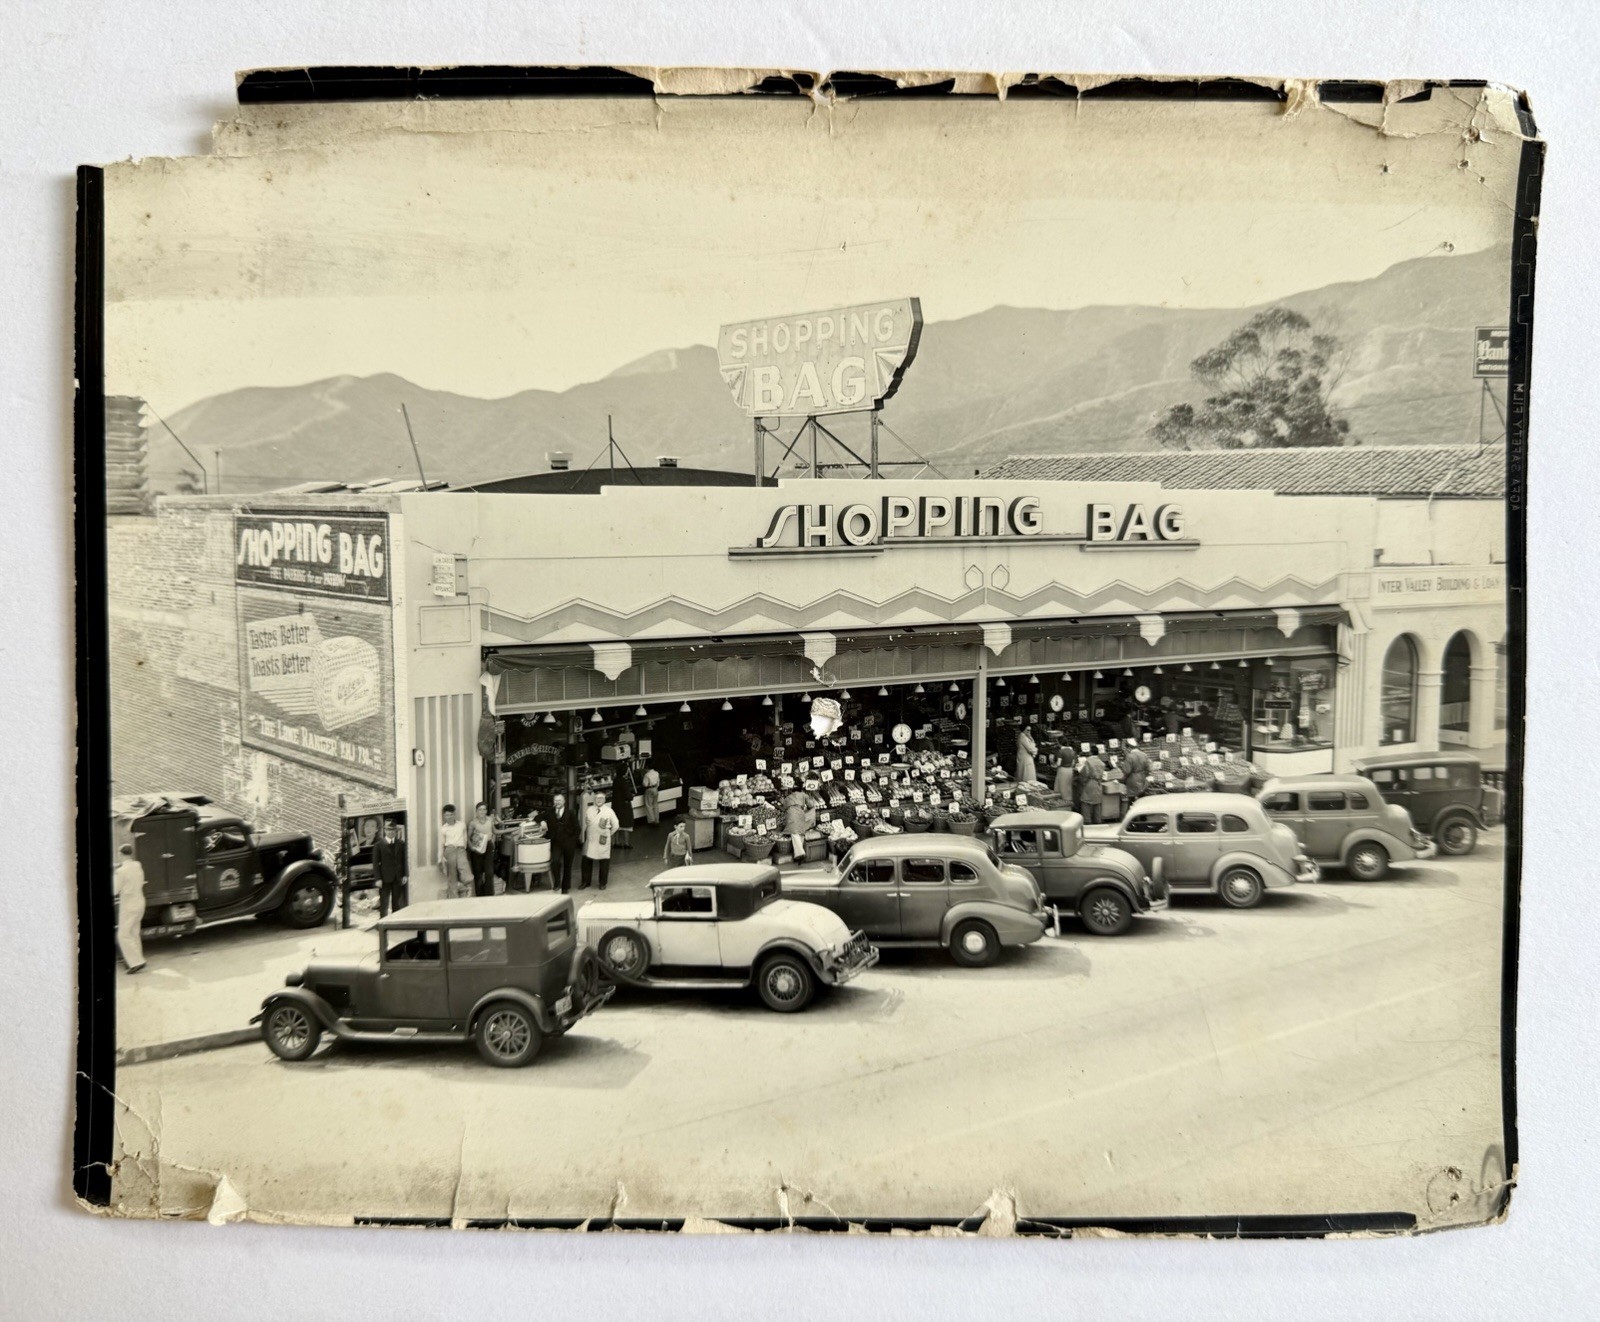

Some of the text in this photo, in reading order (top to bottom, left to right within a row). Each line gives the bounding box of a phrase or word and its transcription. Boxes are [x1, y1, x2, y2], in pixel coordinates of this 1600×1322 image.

[731, 308, 894, 359] SHOPPING
[752, 356, 867, 412] BAG
[756, 496, 1186, 548] SHOPPING BAG
[238, 522, 384, 578] SHOPPING BAG
[1405, 577, 1432, 593] VALLEY
[249, 628, 278, 649] Tastes
[280, 622, 310, 646] Better
[251, 652, 311, 677] Toasts Better
